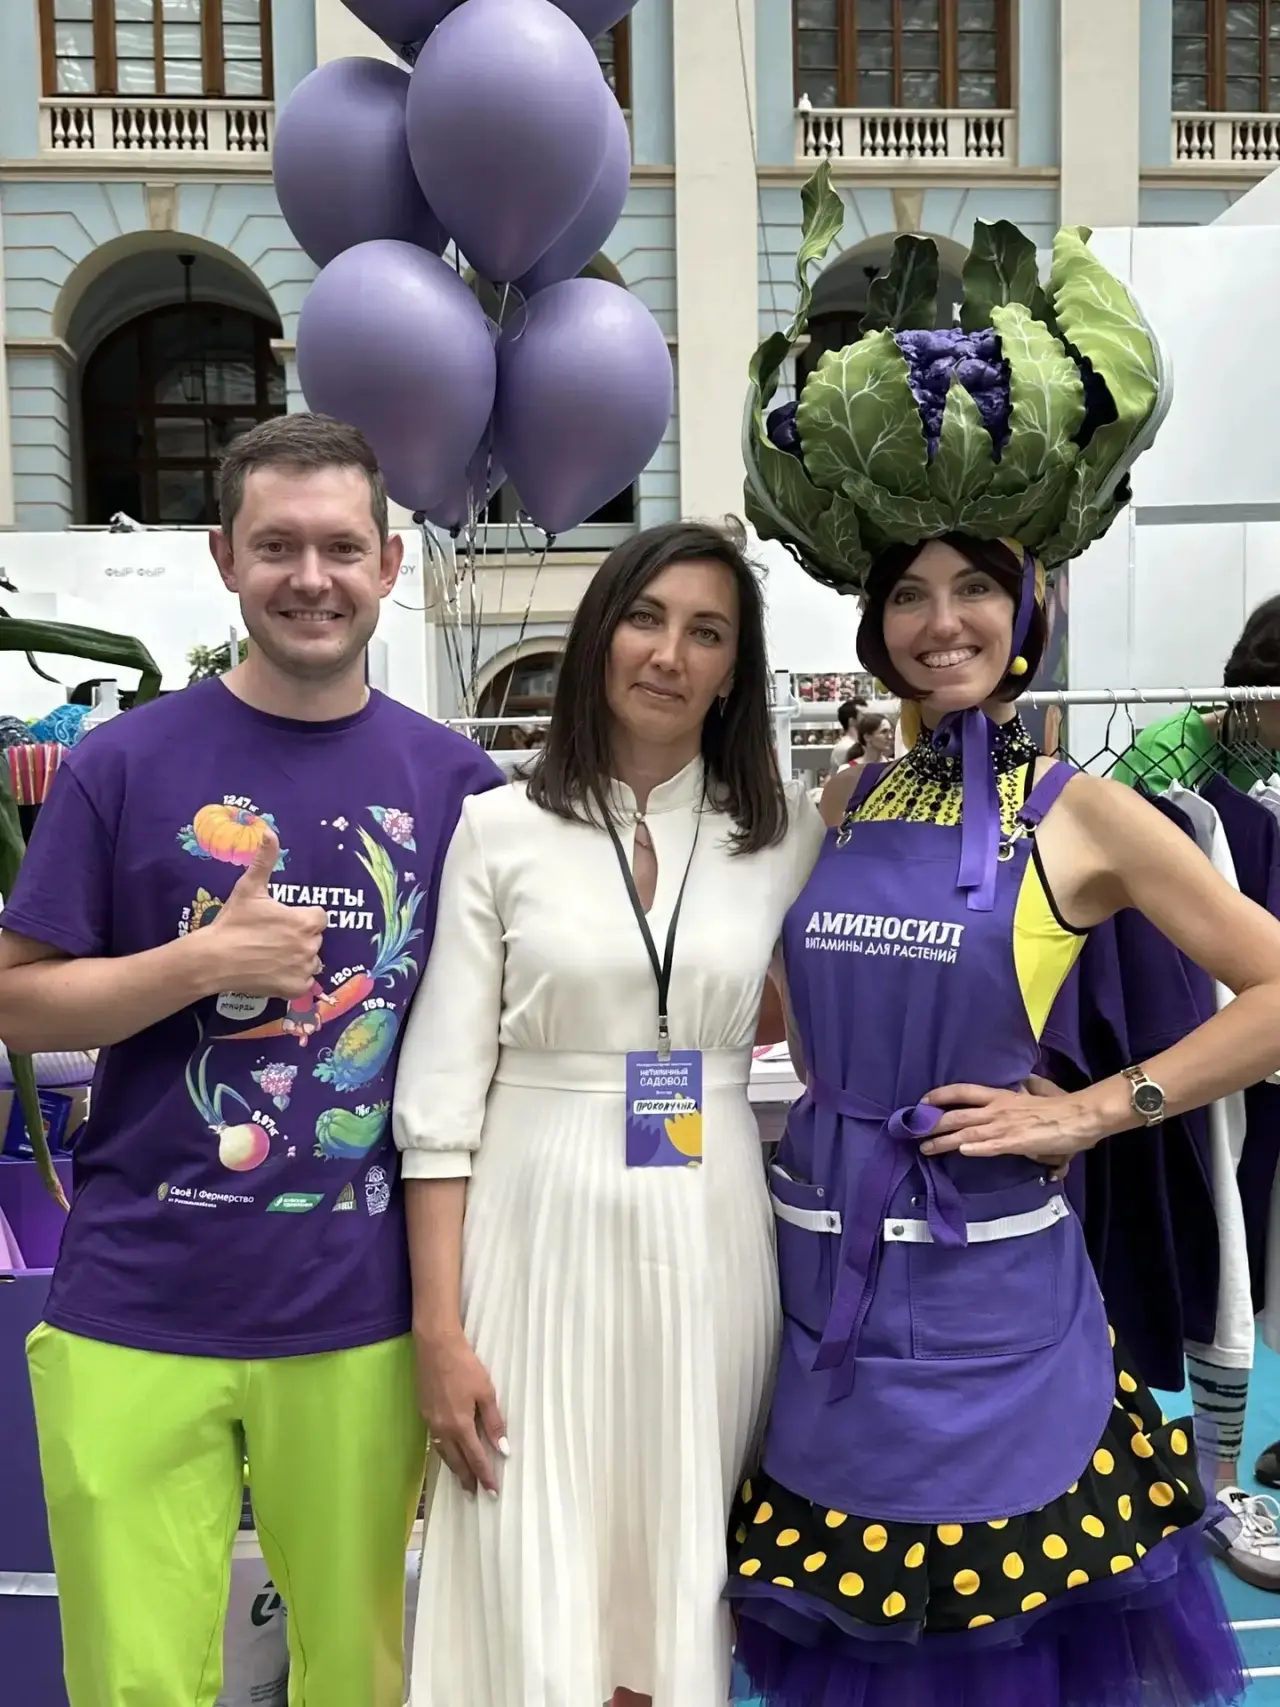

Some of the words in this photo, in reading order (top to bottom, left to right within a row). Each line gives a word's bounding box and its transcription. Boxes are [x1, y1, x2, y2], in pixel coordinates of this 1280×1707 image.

[223, 794, 252, 808] 1247
[805, 911, 965, 947] АМИНОСИЛ
[805, 937, 863, 953] ВИТАМИНЫ
[865, 942, 890, 956] ДЛЯ
[892, 944, 958, 964] РАСТЕНИЙ
[330, 967, 352, 986] 120
[639, 1076, 689, 1087] САДОВОД
[170, 1186, 192, 1197] Своё
[198, 1189, 254, 1203] Фермерство
